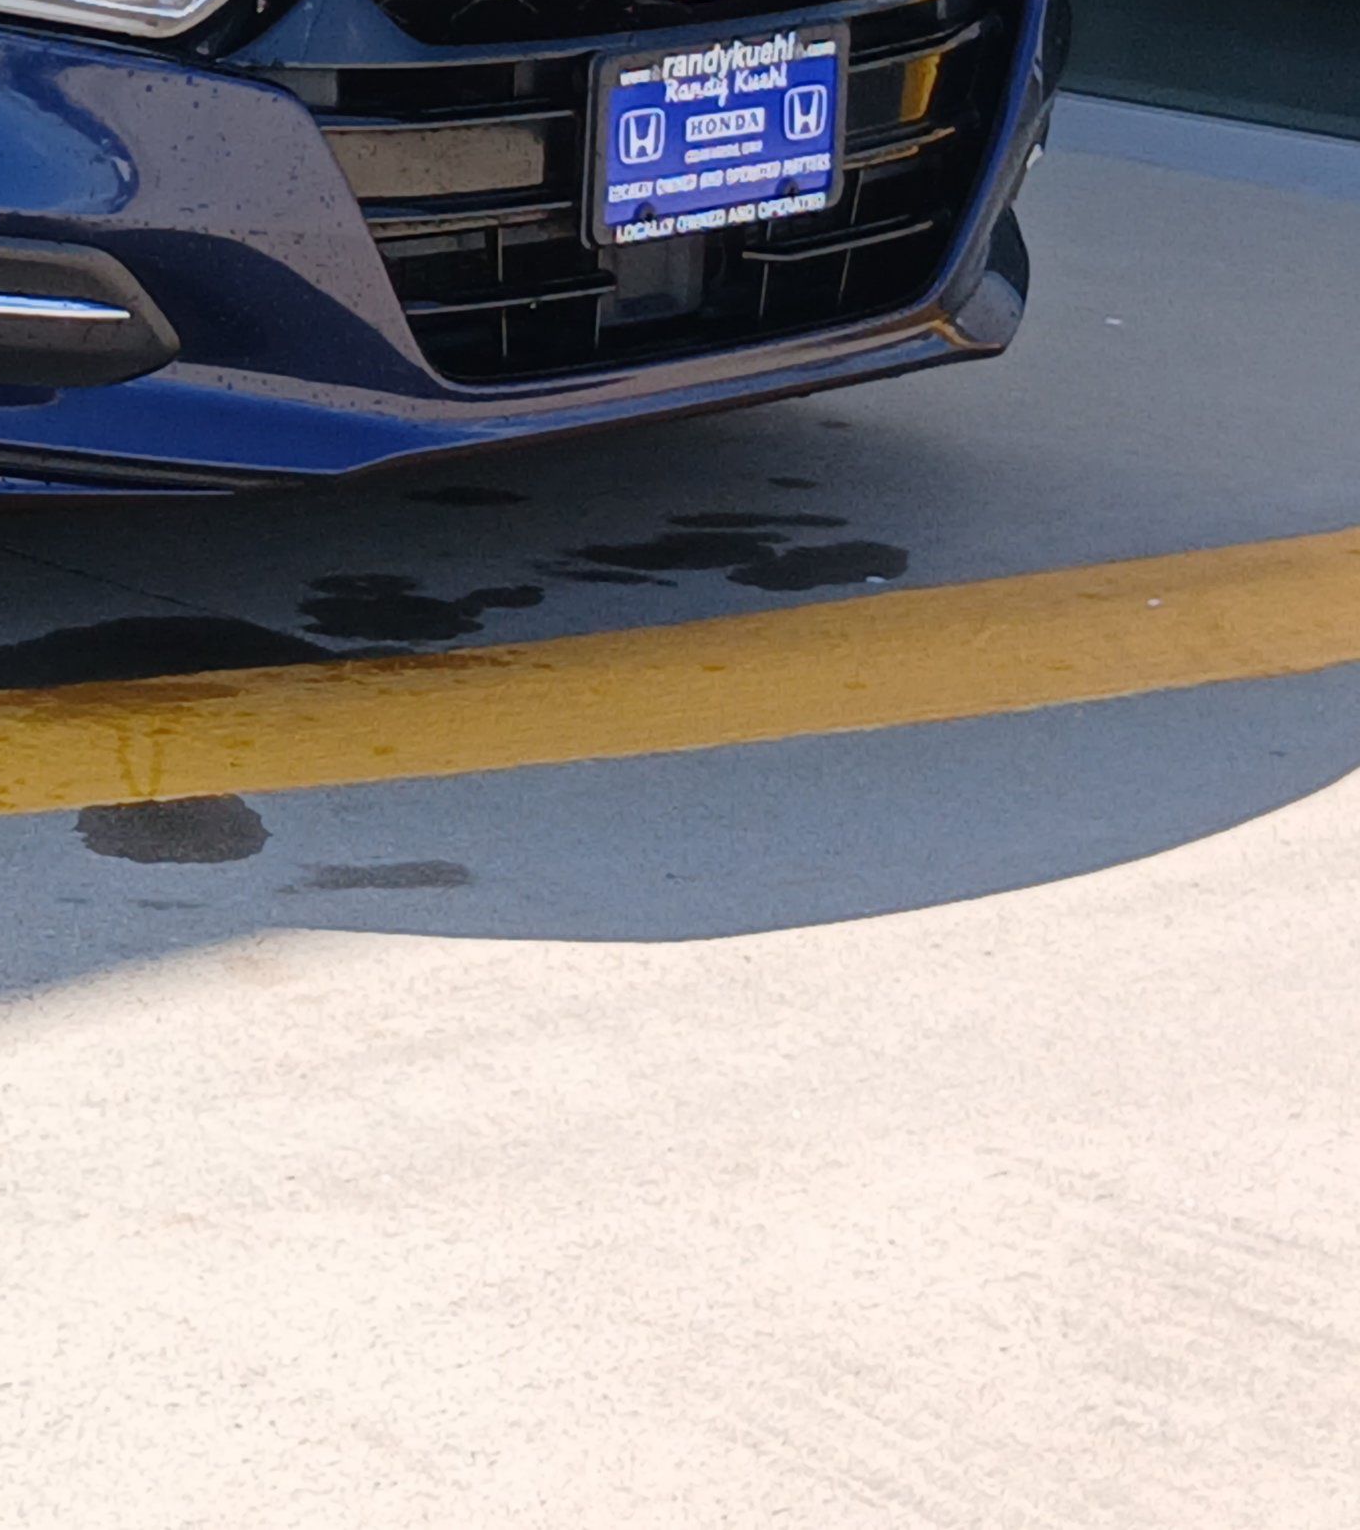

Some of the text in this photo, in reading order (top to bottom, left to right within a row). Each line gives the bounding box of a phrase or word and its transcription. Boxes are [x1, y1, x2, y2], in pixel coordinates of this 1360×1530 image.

[662, 31, 796, 80] randykuehl
[664, 76, 728, 107] Randy
[734, 61, 788, 94] Kuehl
[690, 111, 760, 136] HONDA
[616, 191, 827, 244] LOCALLY OWNED AND OPERATED
